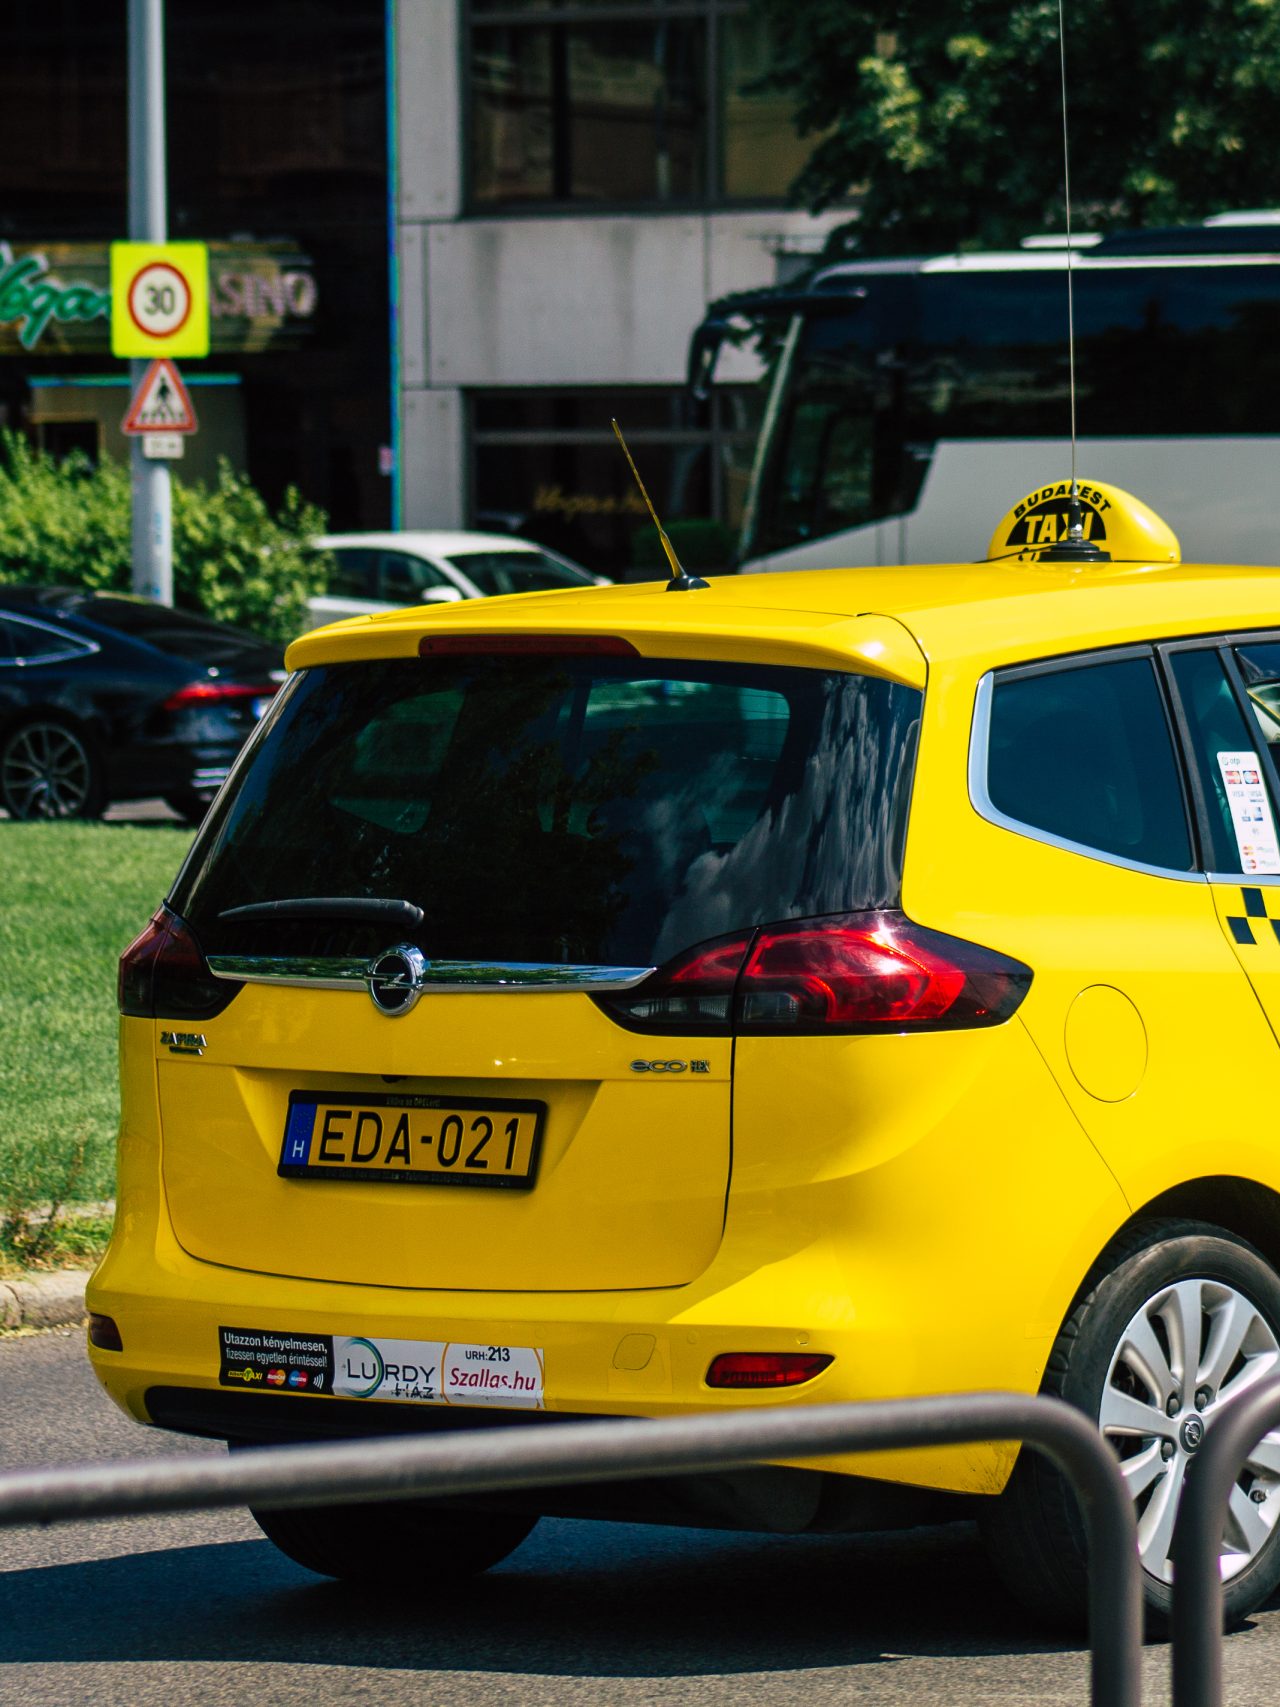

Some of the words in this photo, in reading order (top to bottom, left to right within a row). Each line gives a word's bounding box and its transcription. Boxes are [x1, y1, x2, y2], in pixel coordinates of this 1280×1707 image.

[144, 286, 176, 316] 30
[292, 1140, 305, 1158] H
[318, 1110, 520, 1170] EDA-021
[224, 1332, 261, 1347] Utazzon
[263, 1335, 328, 1354] kényelmesen,
[226, 1347, 255, 1361] fizessen
[256, 1350, 287, 1365] egyetlen
[289, 1352, 328, 1368] érintéssel!
[347, 1358, 436, 1383] LURDY
[449, 1367, 536, 1391] Szallas.hu
